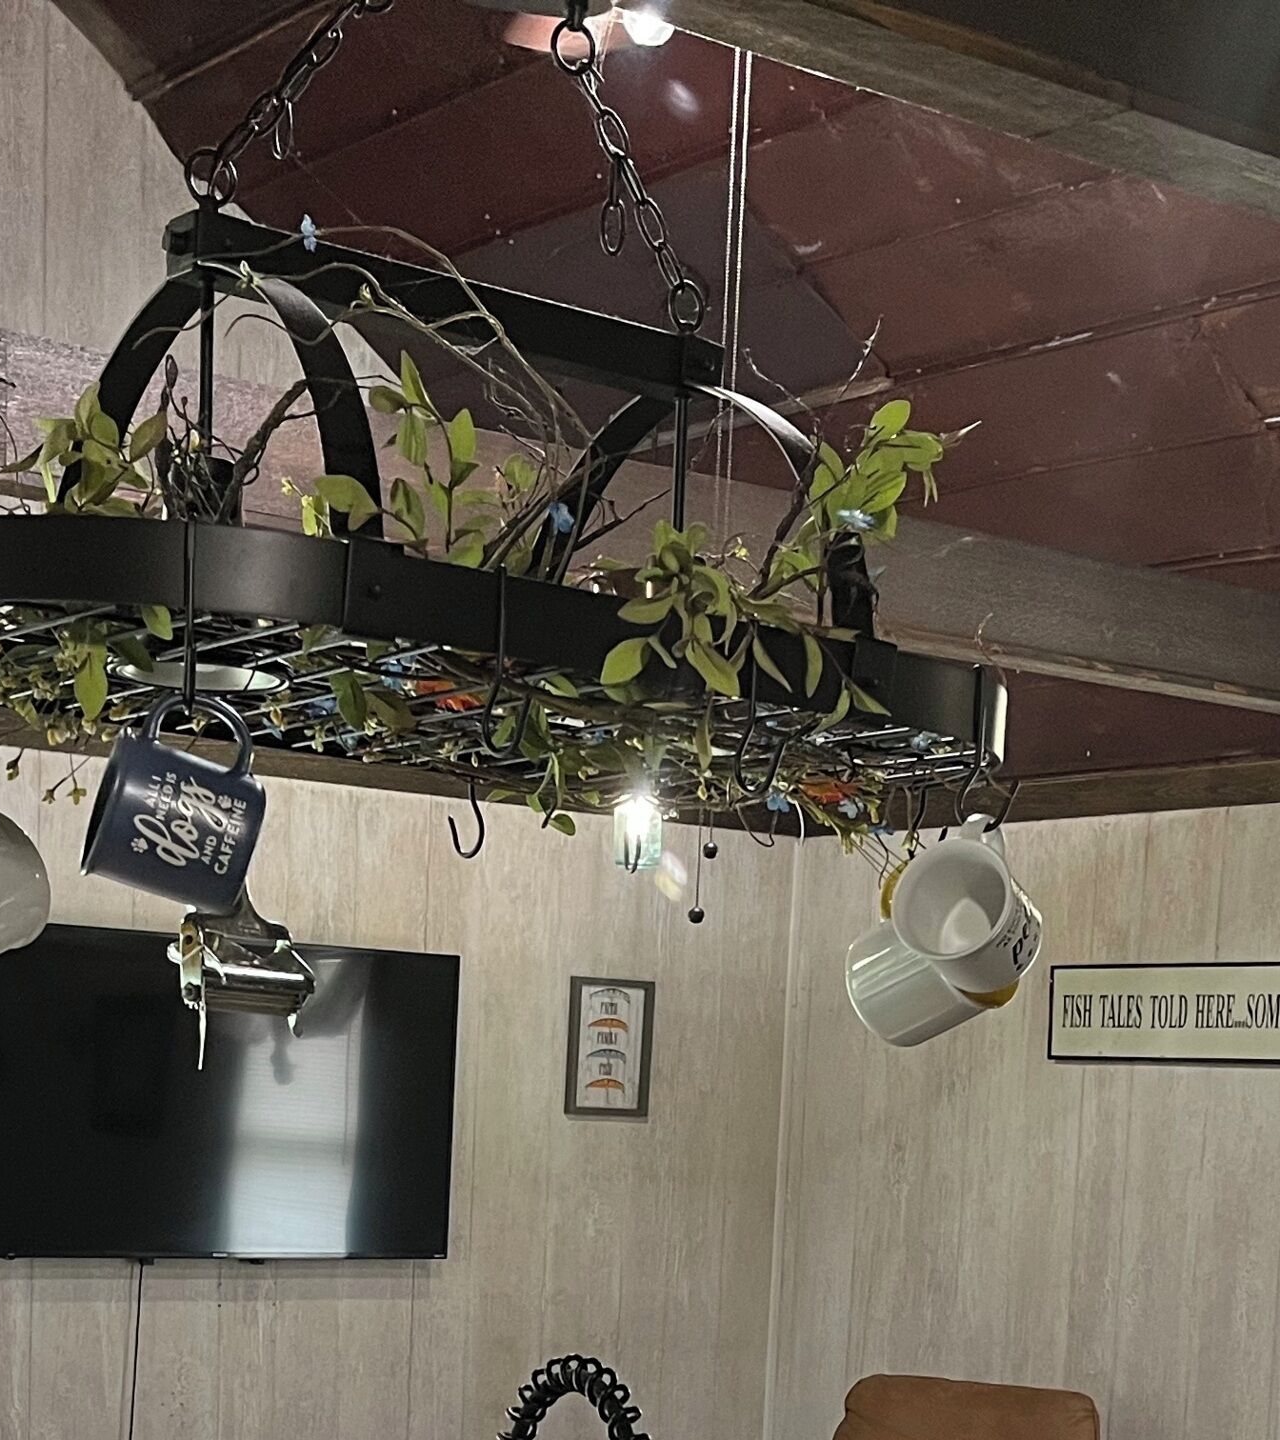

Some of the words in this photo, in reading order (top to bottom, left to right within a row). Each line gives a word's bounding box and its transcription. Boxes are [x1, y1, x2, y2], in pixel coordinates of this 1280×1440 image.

[144, 783, 161, 808] ALL
[155, 784, 174, 820] NEED
[165, 772, 177, 784] IS
[133, 776, 229, 867] dogs
[214, 798, 247, 875] CAFFEINE
[200, 835, 217, 865] AND
[1062, 994, 1093, 1029] FISH
[1099, 994, 1143, 1029] TALES
[1150, 995, 1188, 1029] TOLD
